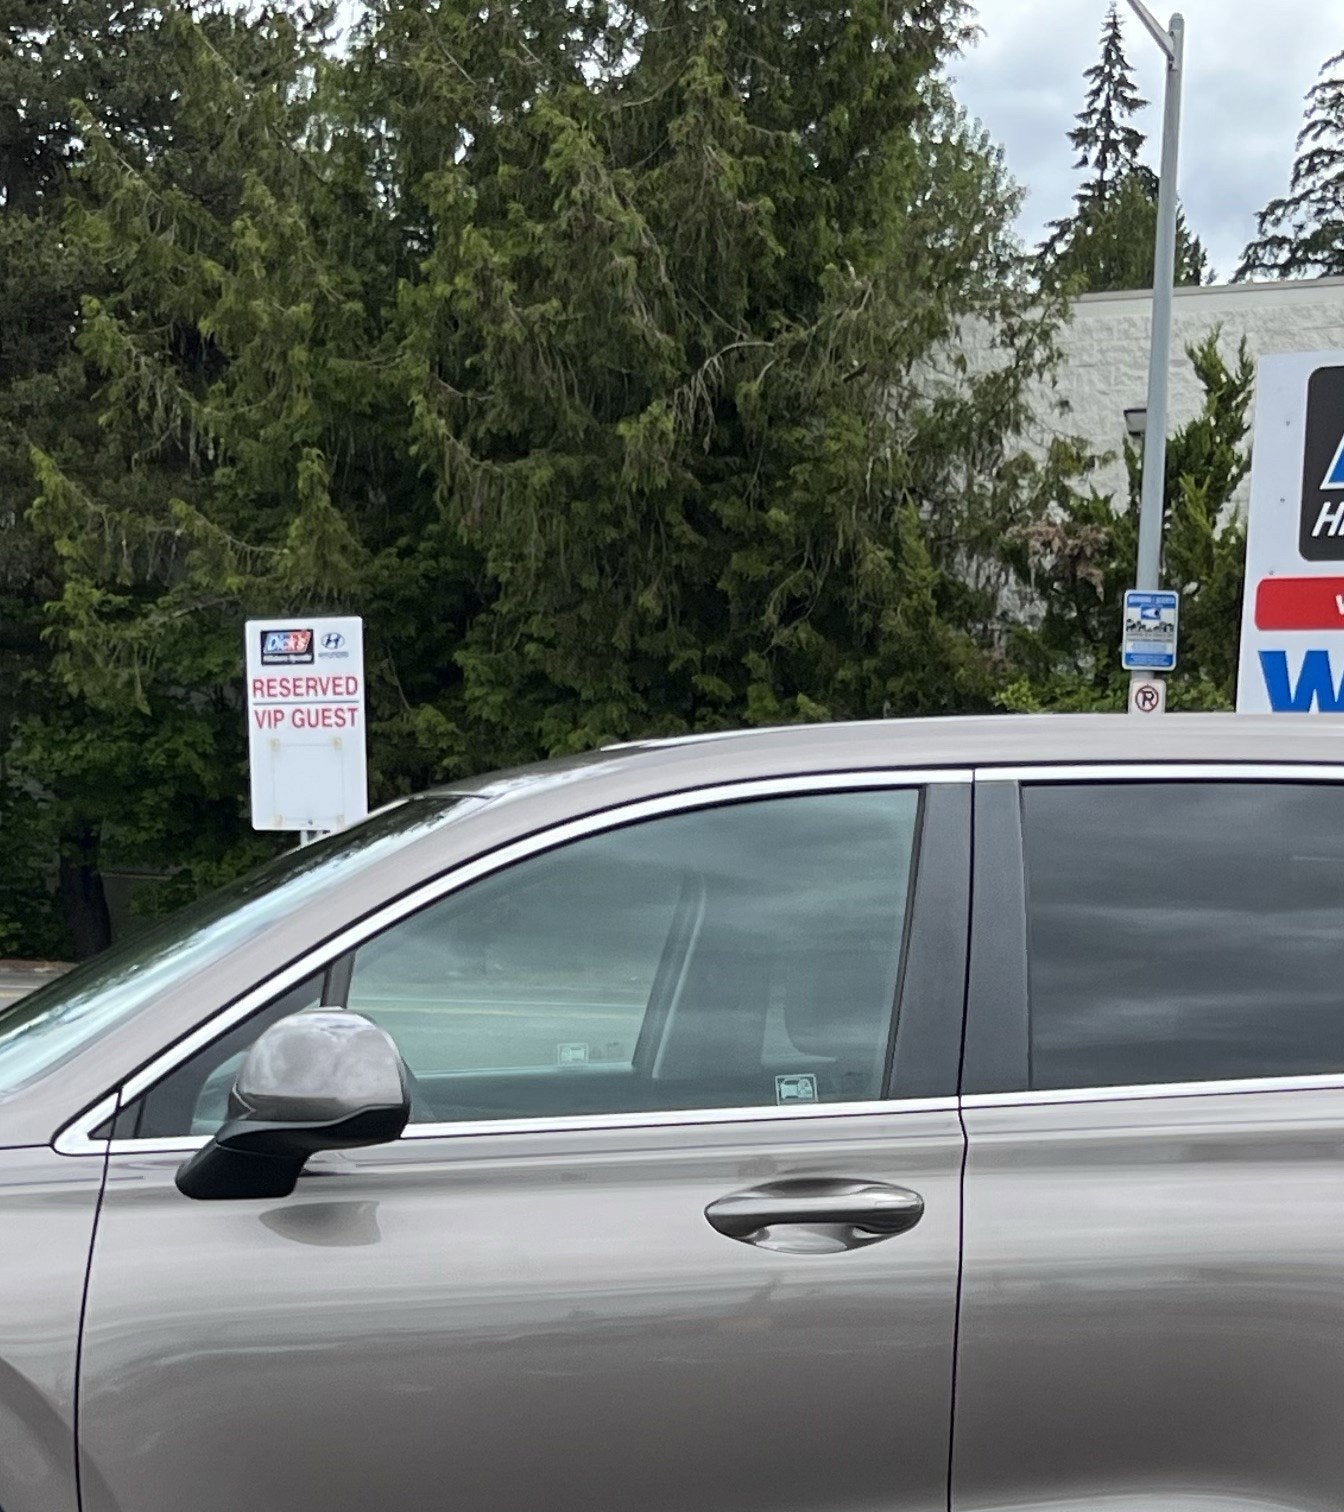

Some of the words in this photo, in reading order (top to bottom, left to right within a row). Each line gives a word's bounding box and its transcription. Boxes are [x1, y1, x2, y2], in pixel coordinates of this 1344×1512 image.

[252, 676, 358, 698] RESERVED
[254, 709, 285, 729] VIP
[291, 707, 358, 729] GUEST
